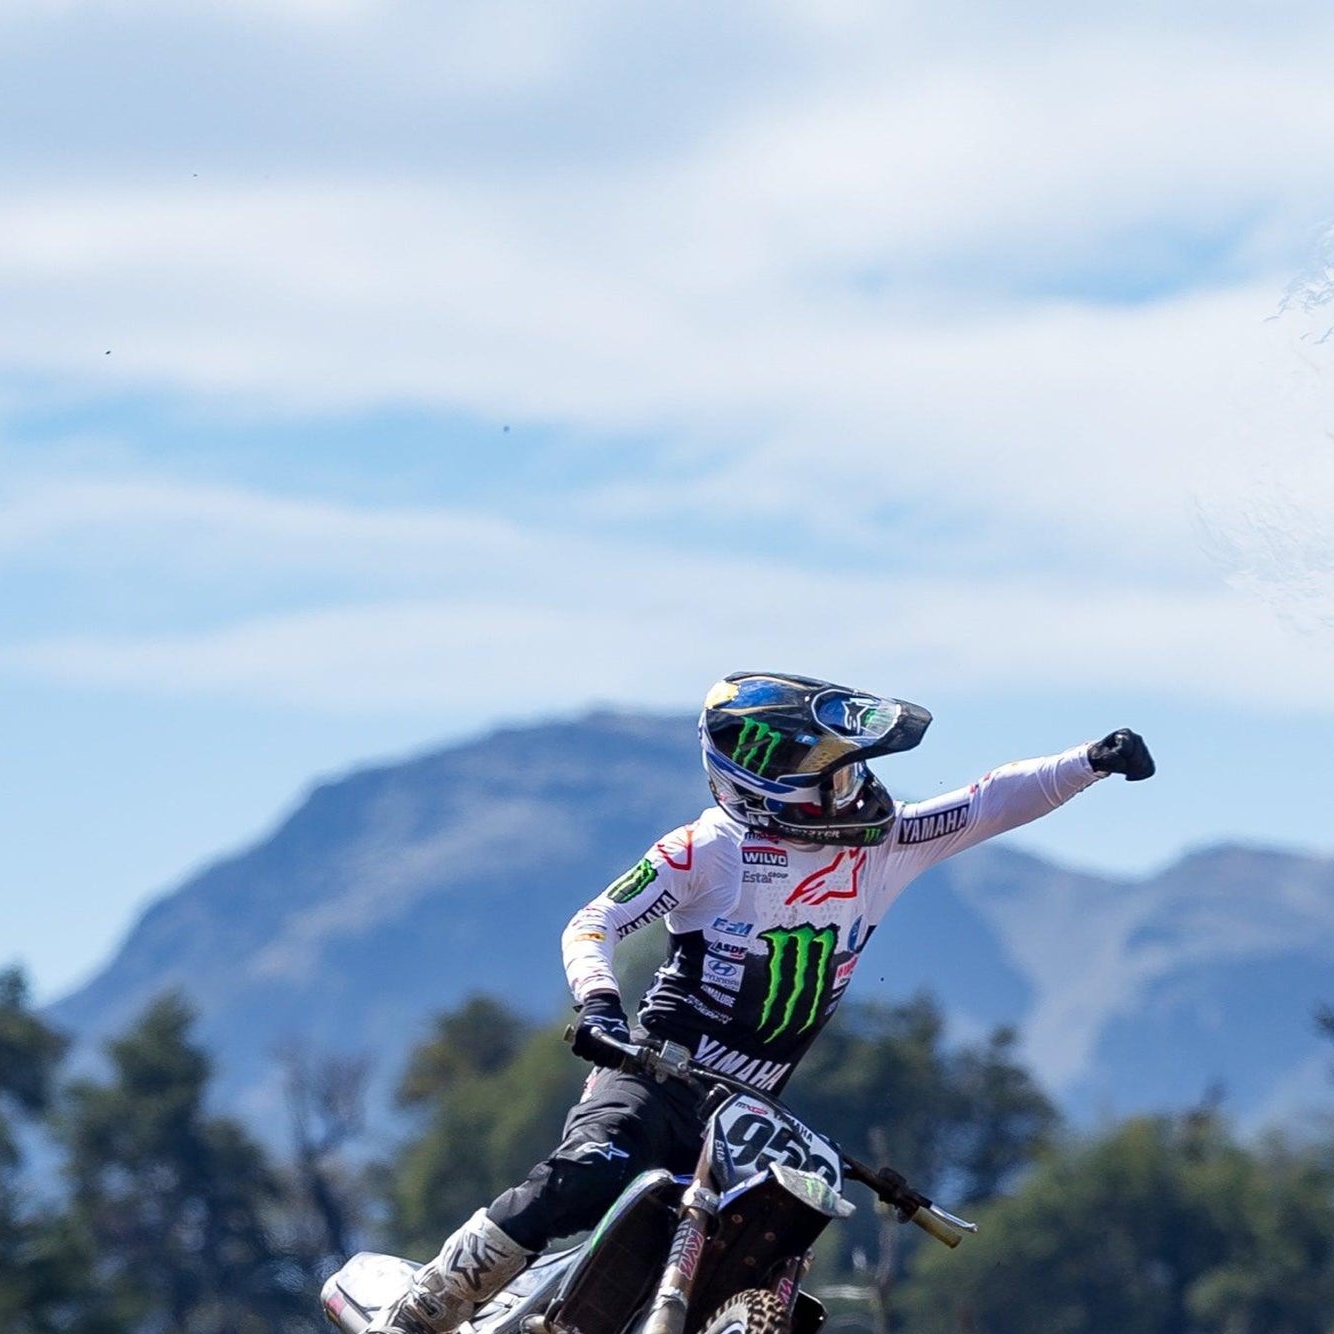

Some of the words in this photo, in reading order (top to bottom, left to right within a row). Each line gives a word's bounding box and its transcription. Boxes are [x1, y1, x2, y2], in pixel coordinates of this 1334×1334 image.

[902, 806, 968, 842] YAMAHA
[744, 852, 787, 865] WILVO
[618, 893, 677, 939] YAMAHA
[694, 1034, 791, 1091] YAMAHA
